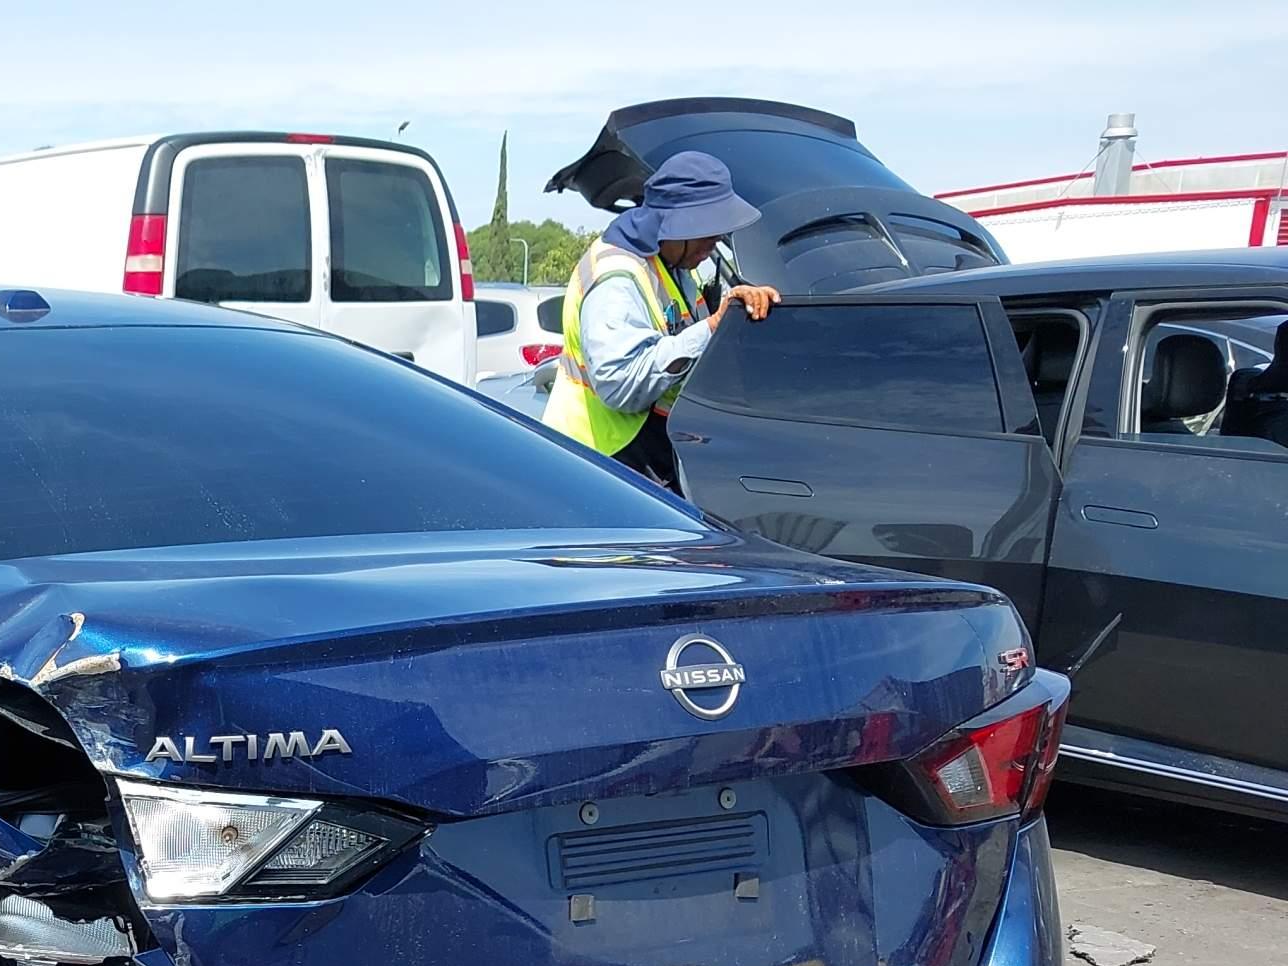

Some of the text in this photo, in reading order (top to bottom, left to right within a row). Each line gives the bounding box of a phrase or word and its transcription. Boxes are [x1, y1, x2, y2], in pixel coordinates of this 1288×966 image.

[1000, 648, 1030, 670] SR
[664, 667, 746, 687] NISSAN
[144, 728, 353, 763] ALTIMA
